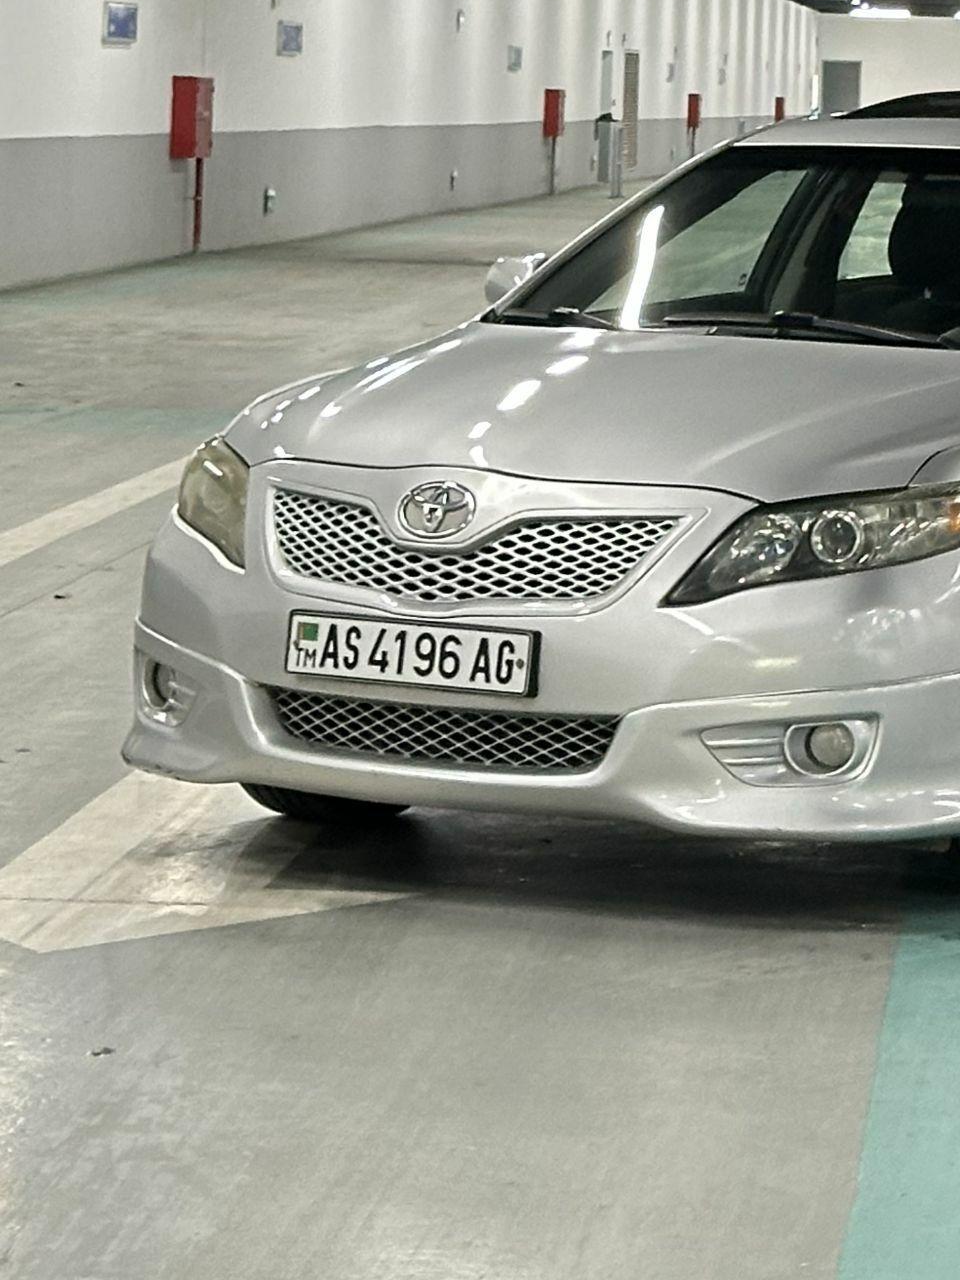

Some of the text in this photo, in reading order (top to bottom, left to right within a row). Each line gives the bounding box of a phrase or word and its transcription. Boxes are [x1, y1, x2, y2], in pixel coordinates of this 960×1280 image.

[295, 646, 317, 669] TM
[318, 623, 515, 685] AS 4196 AG
